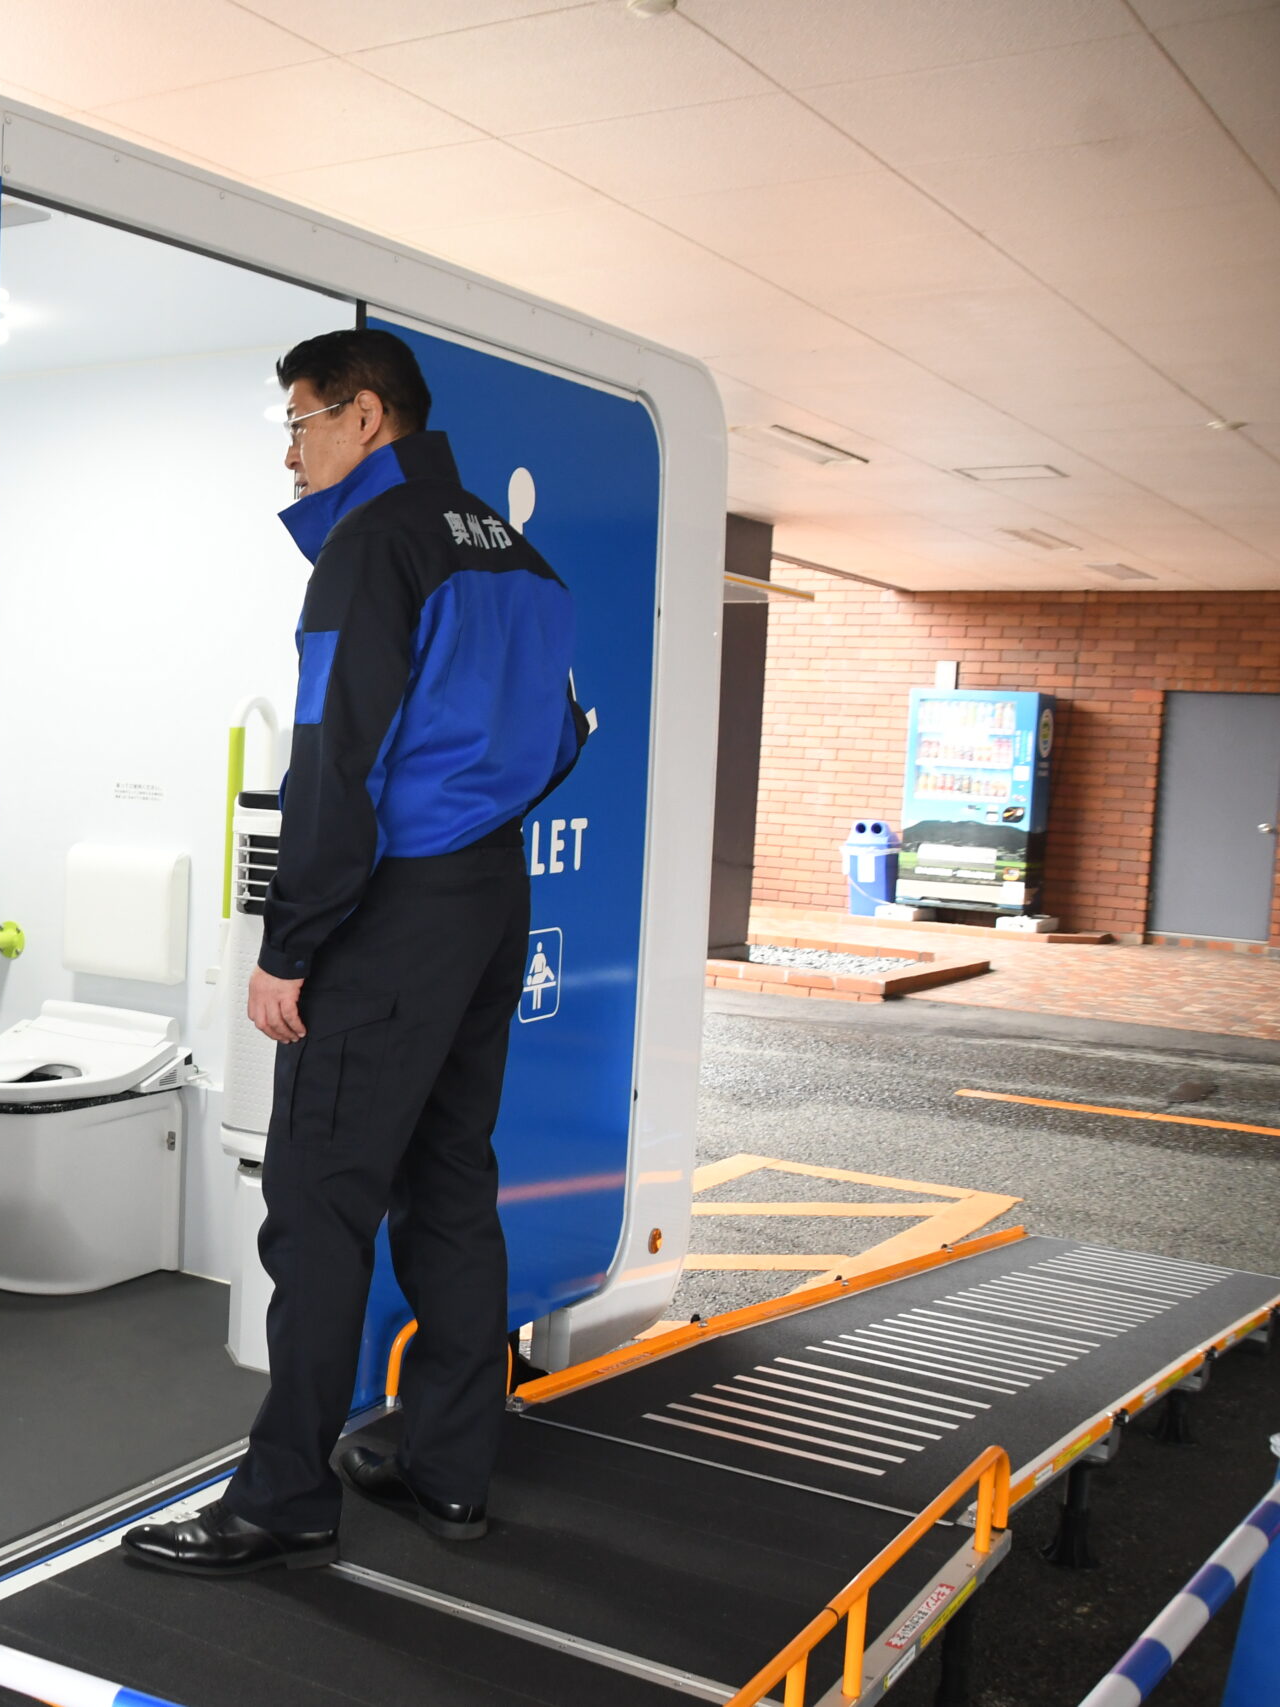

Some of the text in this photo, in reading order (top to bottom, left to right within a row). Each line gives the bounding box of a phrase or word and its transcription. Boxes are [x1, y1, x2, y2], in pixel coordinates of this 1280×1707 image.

[443, 510, 513, 550] 奥州市
[530, 817, 589, 876] LET
